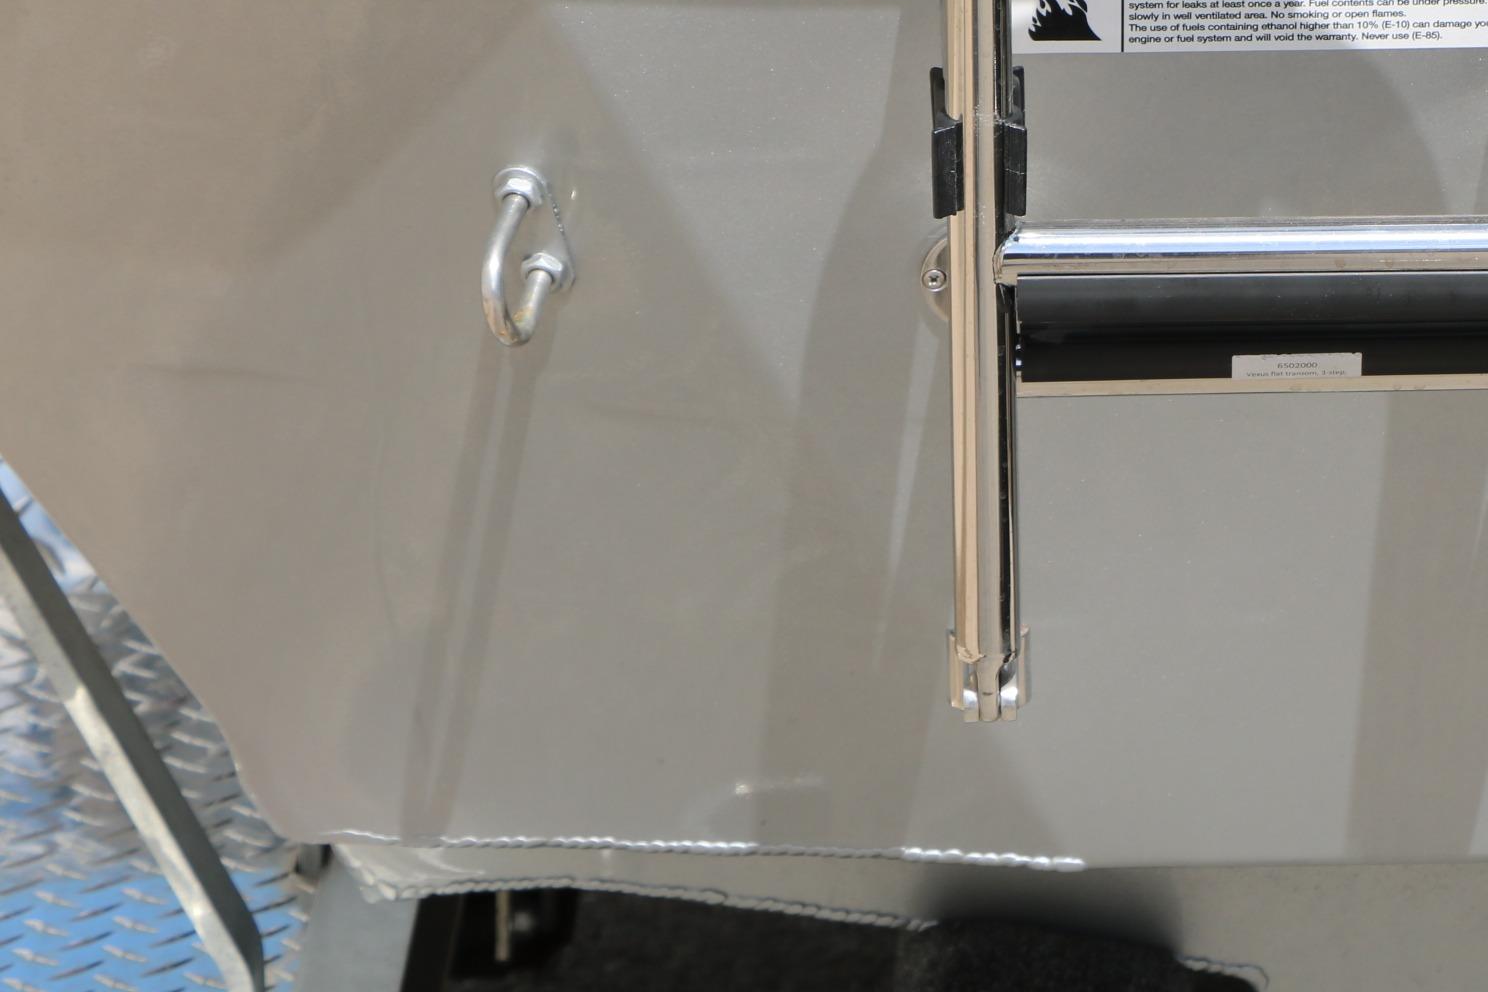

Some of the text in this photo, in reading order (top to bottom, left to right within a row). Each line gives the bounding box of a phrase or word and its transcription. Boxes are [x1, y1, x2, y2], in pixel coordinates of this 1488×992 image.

[1128, 1, 1164, 10] system
[1283, 1, 1306, 9] year.
[1128, 13, 1160, 22] slowly
[1287, 11, 1329, 20] smoking
[1208, 23, 1259, 32] containing
[1300, 21, 1330, 31] higher
[1382, 20, 1410, 30] (E-10)
[1433, 20, 1472, 29] damage
[1128, 35, 1162, 45] engine
[1196, 34, 1232, 44] system
[1315, 33, 1358, 42] warranty.
